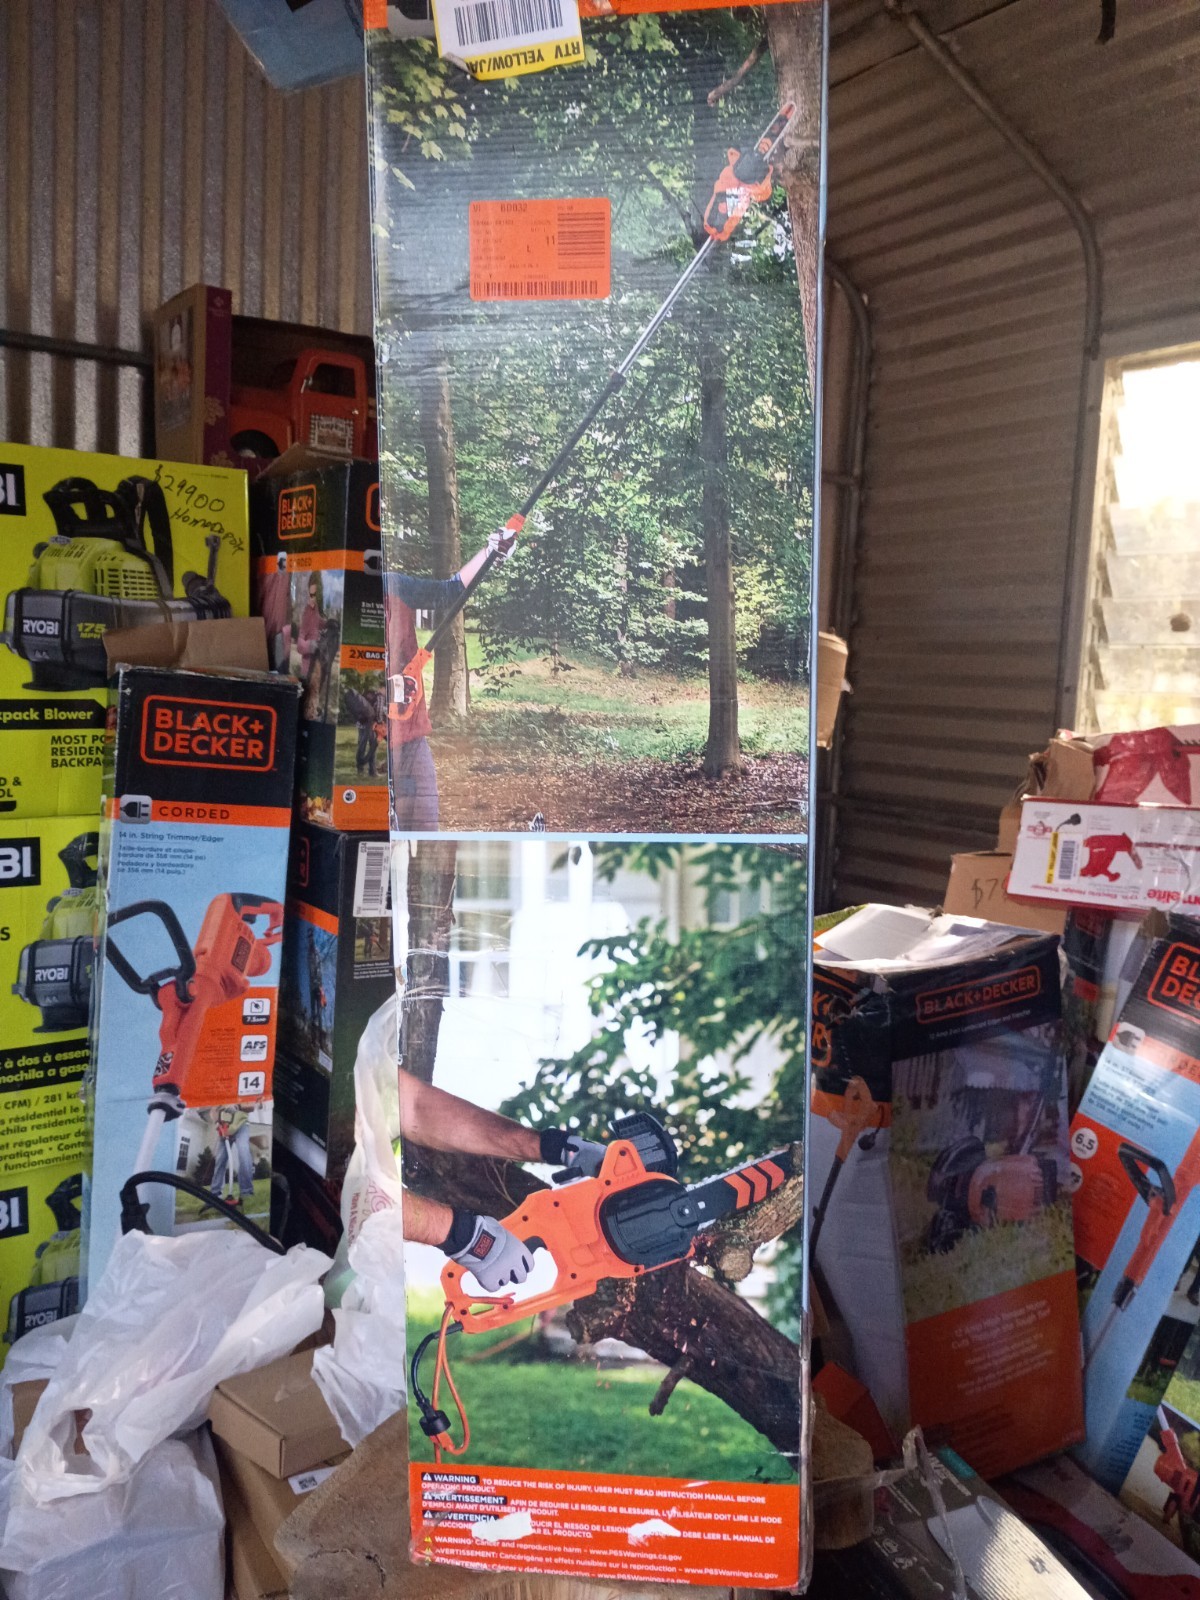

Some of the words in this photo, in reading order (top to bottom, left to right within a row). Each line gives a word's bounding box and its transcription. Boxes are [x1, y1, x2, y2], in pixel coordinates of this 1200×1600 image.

[554, 41, 581, 58] RTV
[465, 48, 545, 74] YELLOW/JA
[0, 473, 16, 506] I
[282, 496, 313, 514] BLACK+
[281, 513, 313, 530] DECKER
[23, 619, 59, 635] RYOBI
[77, 622, 105, 633] 175
[44, 708, 94, 721] Blower
[155, 708, 264, 735] BLACK+
[51, 735, 87, 745] MOST
[153, 731, 264, 759] DECKER
[12, 776, 22, 786] &
[159, 806, 230, 819] CORDED
[140, 832, 164, 841] String
[166, 833, 224, 843] Trimmer/Edger
[35, 966, 69, 982] RYOBI
[923, 974, 1036, 1015] BLACK+DECKER
[244, 1040, 267, 1050] AFS
[17, 1056, 40, 1067] dos
[47, 1068, 56, 1077] a
[242, 1077, 260, 1089] 14
[4, 1099, 32, 1110] CFM)
[44, 1093, 62, 1104] 281
[1074, 1132, 1095, 1151] 6.5
[24, 1309, 59, 1328] RYOBI
[433, 1474, 477, 1484] WARNING
[482, 1478, 493, 1486] TO
[493, 1478, 522, 1487] REDUCE
[523, 1480, 537, 1488] THE
[538, 1481, 553, 1490] RISK
[594, 1486, 612, 1494] USER
[613, 1486, 634, 1495] MUST
[634, 1488, 655, 1497] READ
[655, 1489, 703, 1500] INSTRUCTION
[704, 1493, 736, 1502] MANUAL
[736, 1494, 766, 1504] BEFORE
[462, 1483, 496, 1493] PRODUCT.
[432, 1493, 504, 1504] AVERTISSEMENT
[510, 1499, 527, 1507] AFIN
[580, 1503, 607, 1512] RISQUE
[713, 1513, 732, 1521] DOIT
[732, 1514, 749, 1522] LIRE
[760, 1516, 782, 1524] MODE
[455, 1502, 478, 1511] AVANT
[479, 1504, 517, 1513] D'UTILISER
[543, 1528, 551, 1536] EL
[552, 1529, 593, 1539] PRODUCTO.
[553, 1521, 562, 1529] EL
[563, 1521, 590, 1531] RIESGO
[591, 1523, 601, 1531] DE
[682, 1530, 702, 1539] DEBE
[703, 1531, 721, 1540] LEER
[722, 1533, 732, 1541] EL
[732, 1533, 764, 1543] MANUAL
[765, 1535, 775, 1544] DE
[501, 1540, 516, 1549] and
[516, 1542, 562, 1553] reproductive
[563, 1545, 582, 1553] harm
[545, 1556, 553, 1564] et
[553, 1556, 574, 1565] effets
[576, 1558, 607, 1567] nuisibles
[621, 1561, 629, 1569] la
[629, 1562, 677, 1573] reproduction
